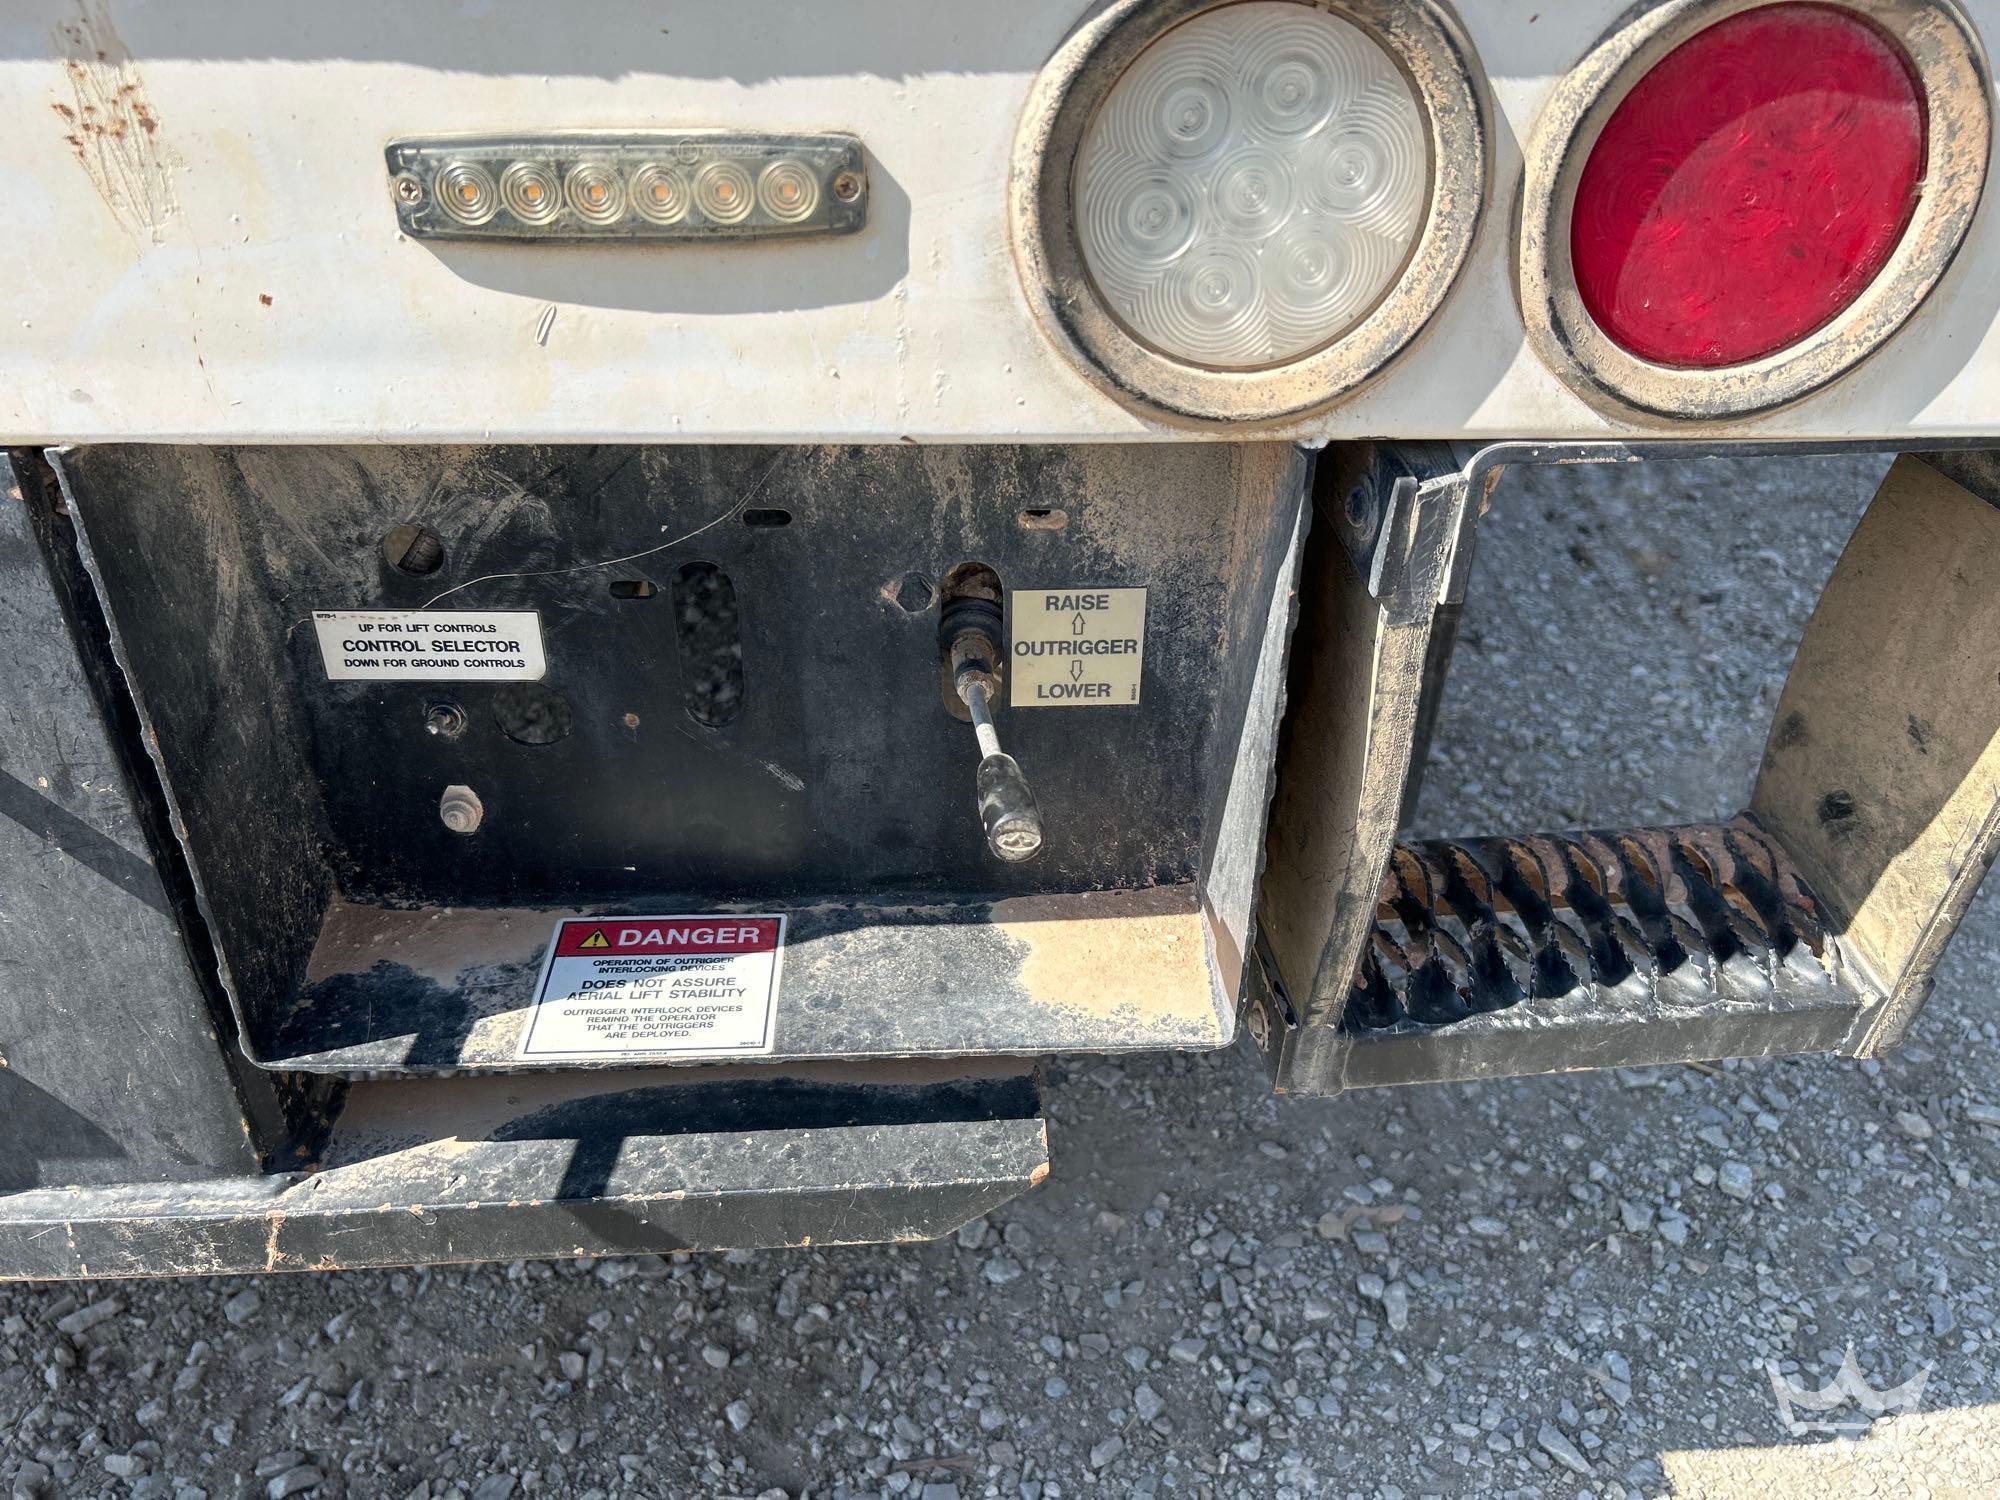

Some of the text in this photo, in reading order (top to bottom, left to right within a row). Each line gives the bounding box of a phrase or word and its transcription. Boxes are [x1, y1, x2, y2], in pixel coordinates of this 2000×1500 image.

[1045, 594, 1110, 611] RAISE
[358, 623, 497, 633] UP FOR LIFT CONTROLS
[342, 639, 521, 653] CONTROL SELECTOR
[1014, 639, 1138, 656] OUTRIGGER
[344, 658, 526, 668] DOWN FOR GROUND CONTROLS
[1037, 683, 1112, 699] LOWER
[618, 927, 760, 946] DANGER
[674, 957, 734, 965] OUTRIGGER
[598, 964, 726, 974] INTERLOCKING DEVICES
[581, 977, 736, 990] DOES NOT ASSURE
[566, 988, 746, 1001] AERIAL LIFT STABILITY
[563, 1008, 627, 1016] OUTRIGGER
[631, 1006, 692, 1014] INTERLOCK
[659, 1013, 716, 1021] OPERATOR
[643, 1021, 714, 1030] OUTRIGGERS
[604, 1030, 692, 1039] ARE DEPLOYED.
